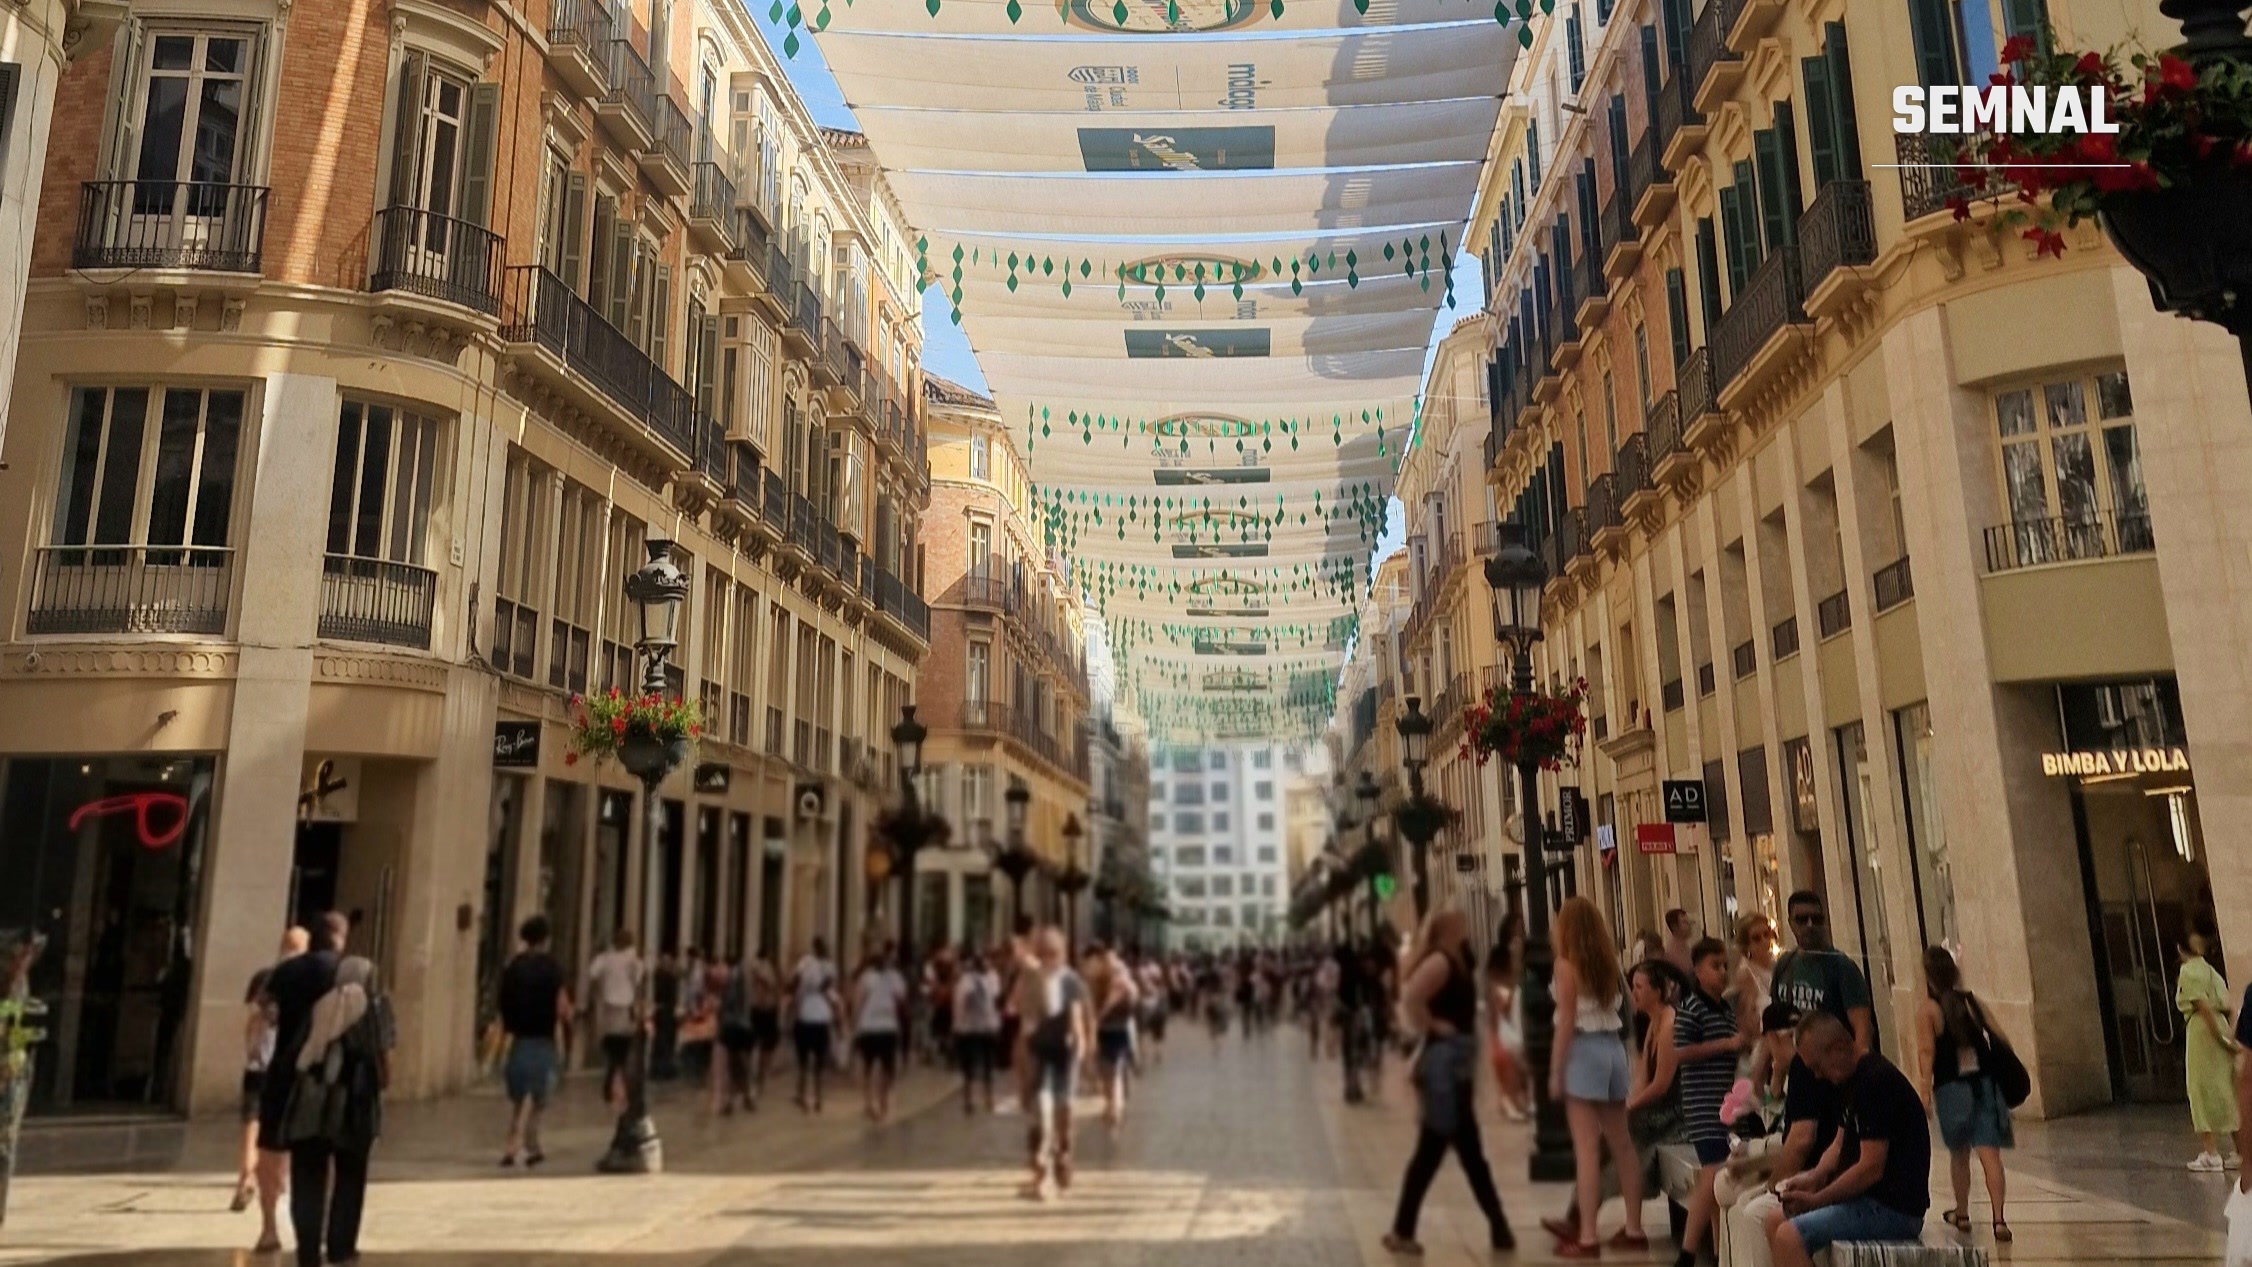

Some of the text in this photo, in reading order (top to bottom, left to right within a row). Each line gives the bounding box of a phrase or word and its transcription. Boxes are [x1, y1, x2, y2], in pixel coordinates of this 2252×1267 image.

[2041, 747, 2190, 776] BIMBA Y LOLA
[1669, 786, 1699, 803] AD
[1562, 789, 1575, 843] PRIMOR
